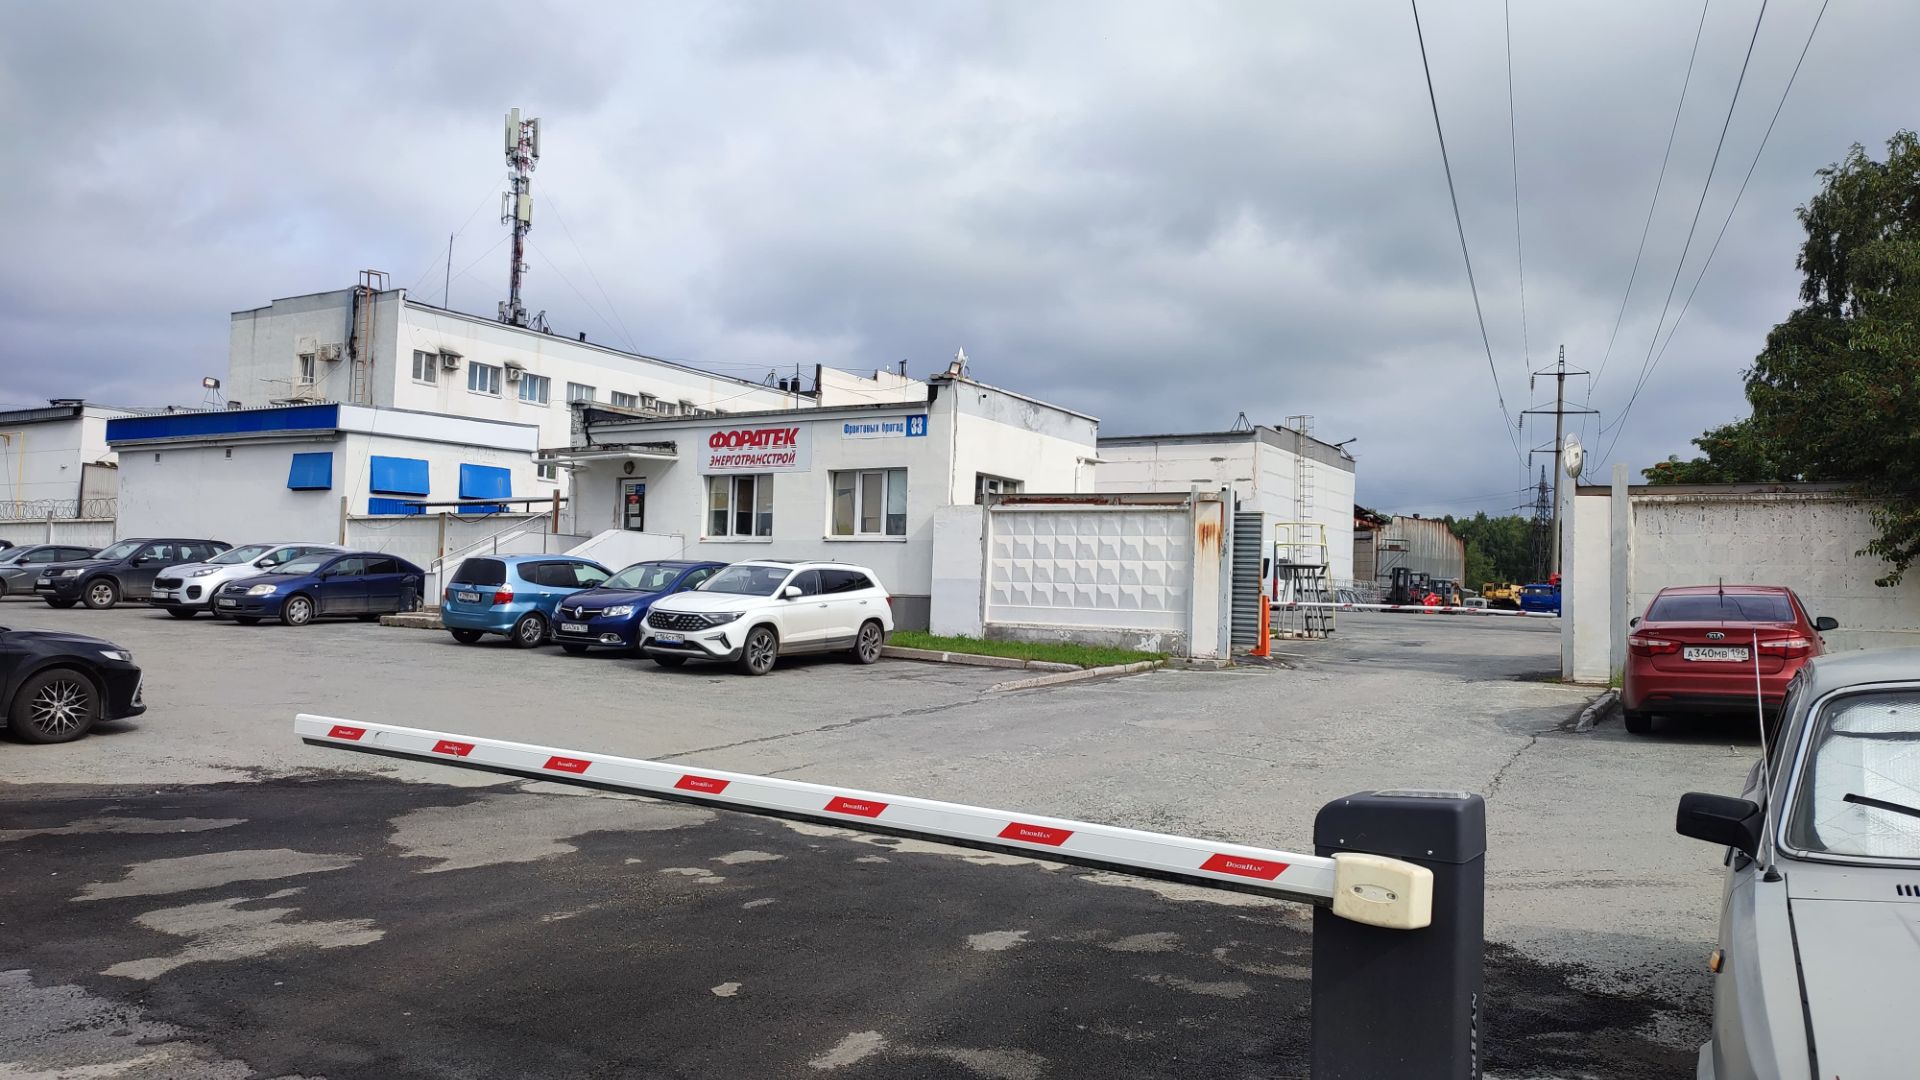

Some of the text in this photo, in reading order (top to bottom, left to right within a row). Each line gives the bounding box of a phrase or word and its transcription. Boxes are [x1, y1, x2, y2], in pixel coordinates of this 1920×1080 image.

[844, 417, 923, 435] Фронтовых бригад 33
[709, 427, 800, 448] ФОРАТЕК
[709, 449, 796, 466] ЭНЕРГОТРАНССТРОЙ
[1730, 648, 1746, 656] 196
